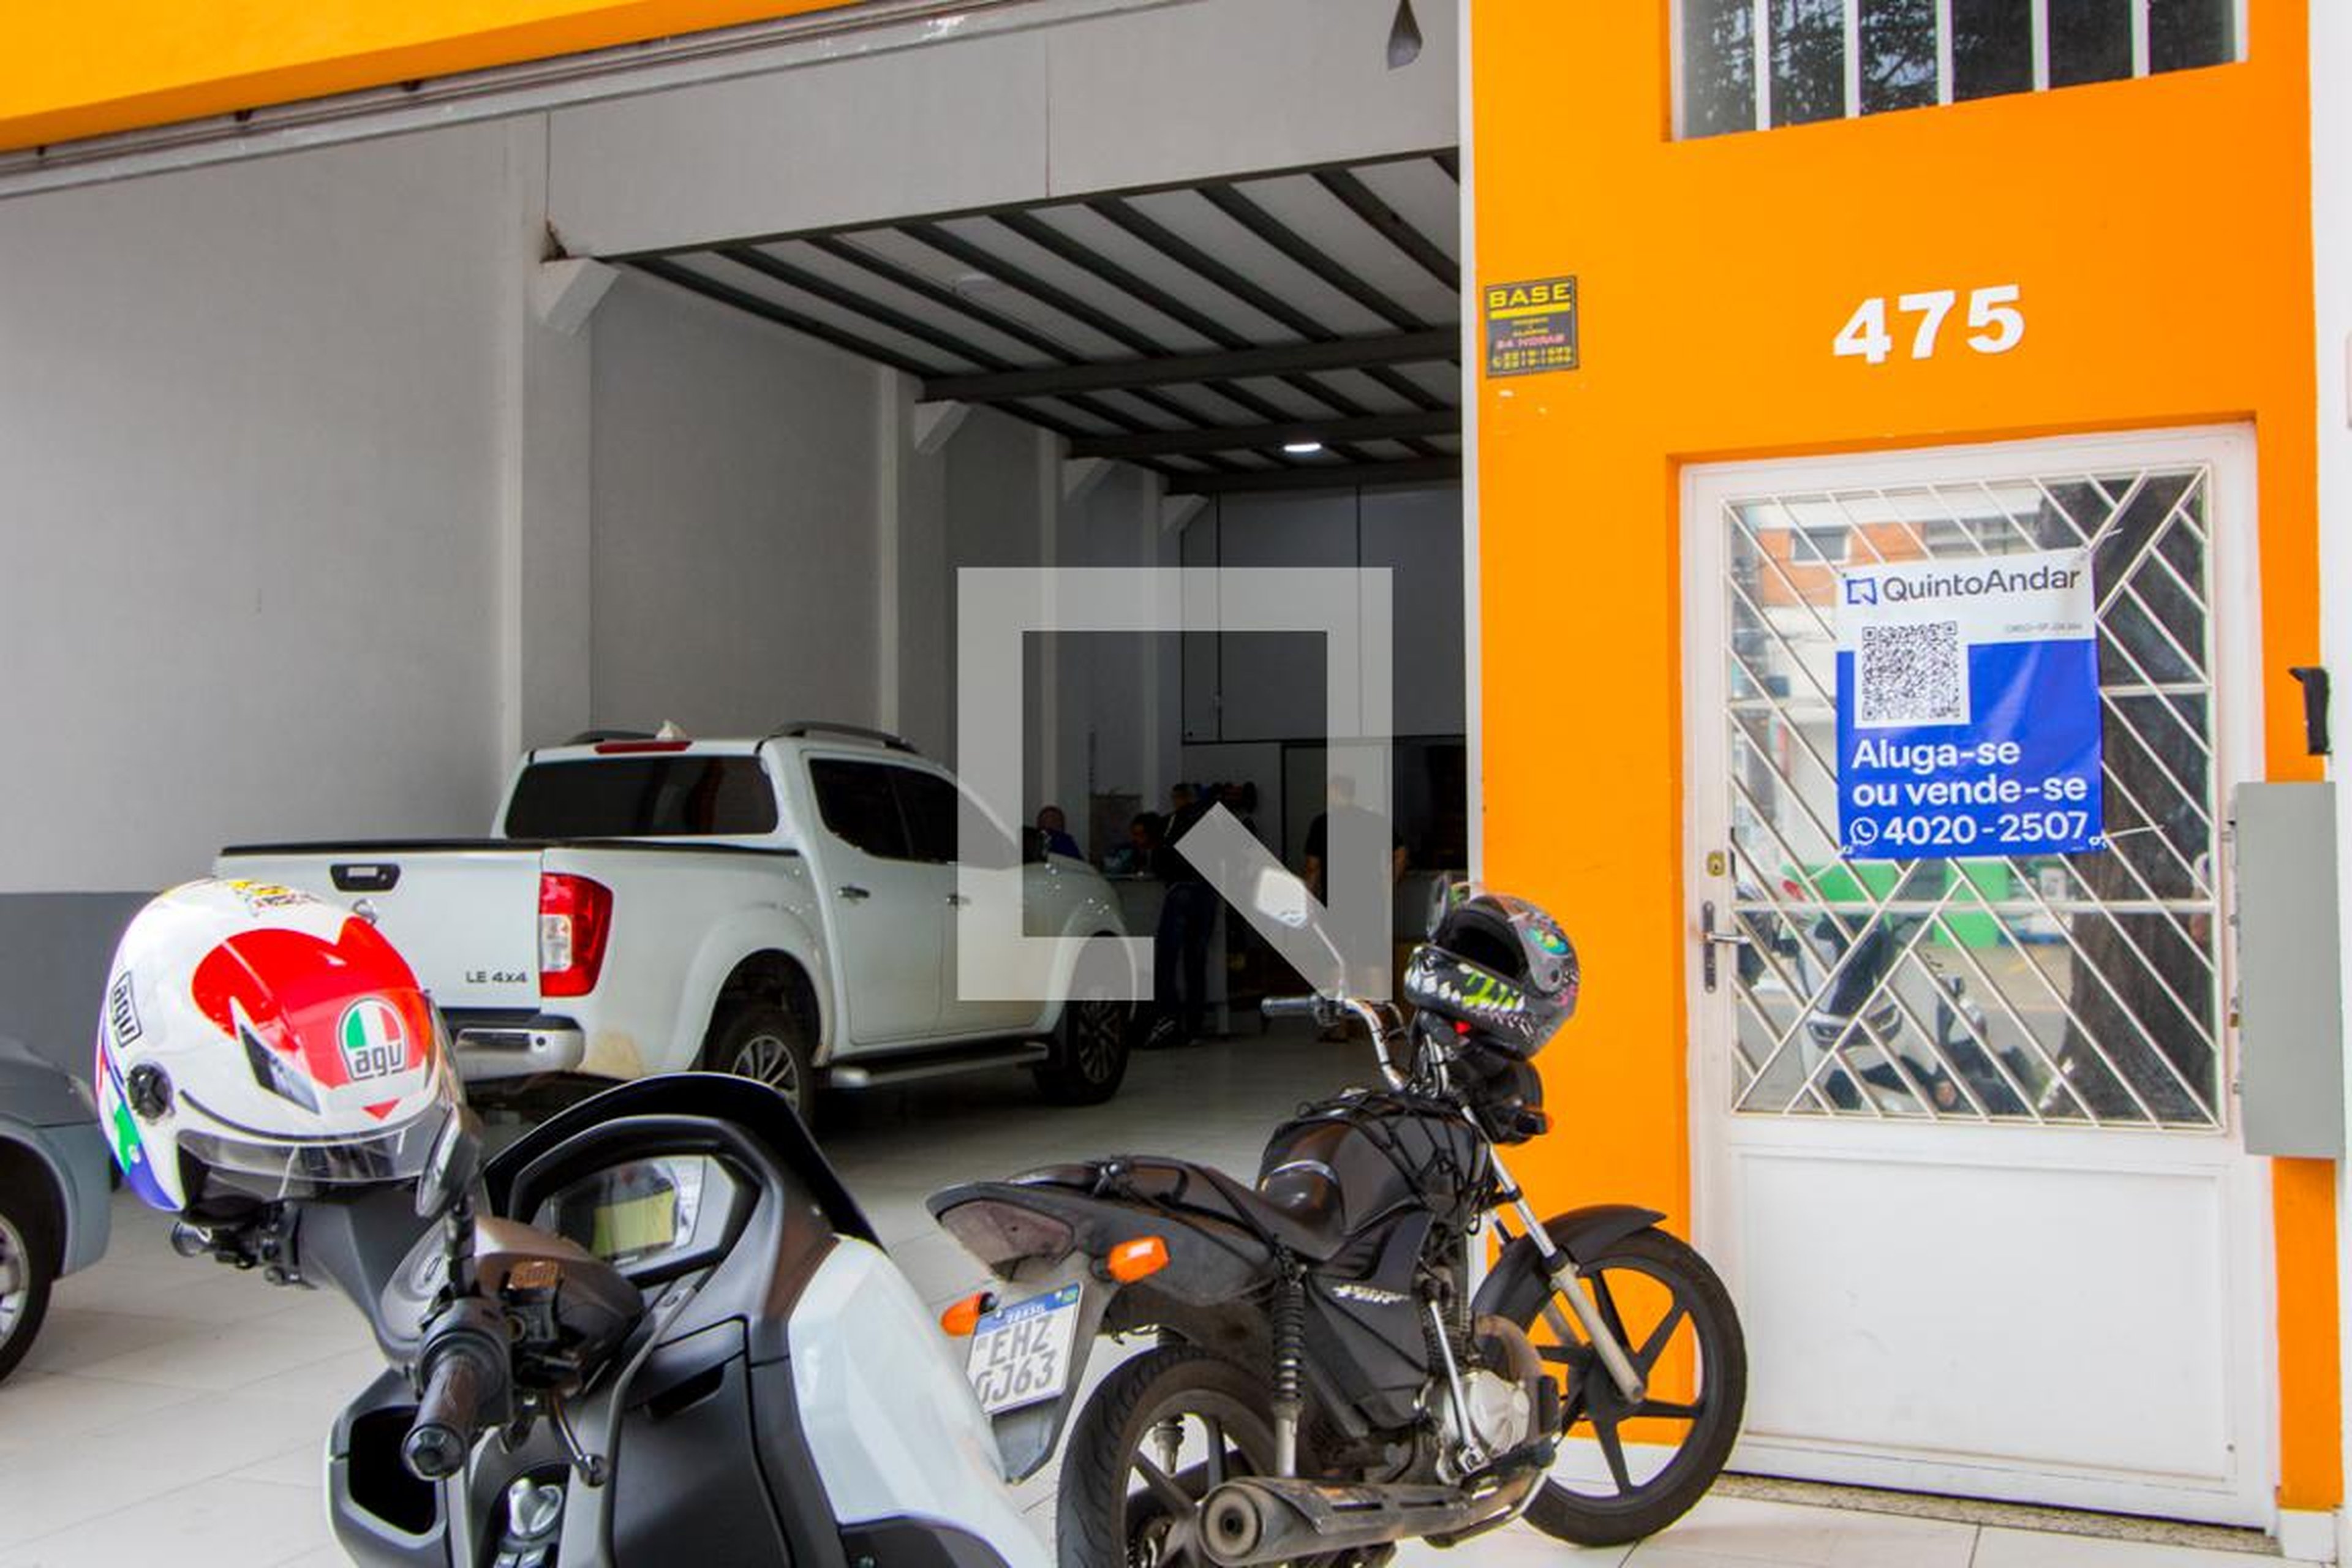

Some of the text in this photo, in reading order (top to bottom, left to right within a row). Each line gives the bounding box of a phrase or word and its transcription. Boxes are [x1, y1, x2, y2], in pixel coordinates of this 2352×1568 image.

[1489, 282, 1571, 309] BASE
[1833, 284, 2026, 365] 475
[1883, 565, 2082, 602] QuintoAndar
[1852, 739, 2020, 775] Aluga-se
[1853, 774, 2088, 807] ou vende-se
[1883, 811, 2089, 845] 4020-2507
[466, 971, 527, 983] LE 4x4
[355, 1042, 402, 1077] agv
[989, 1314, 1054, 1366] EHZ
